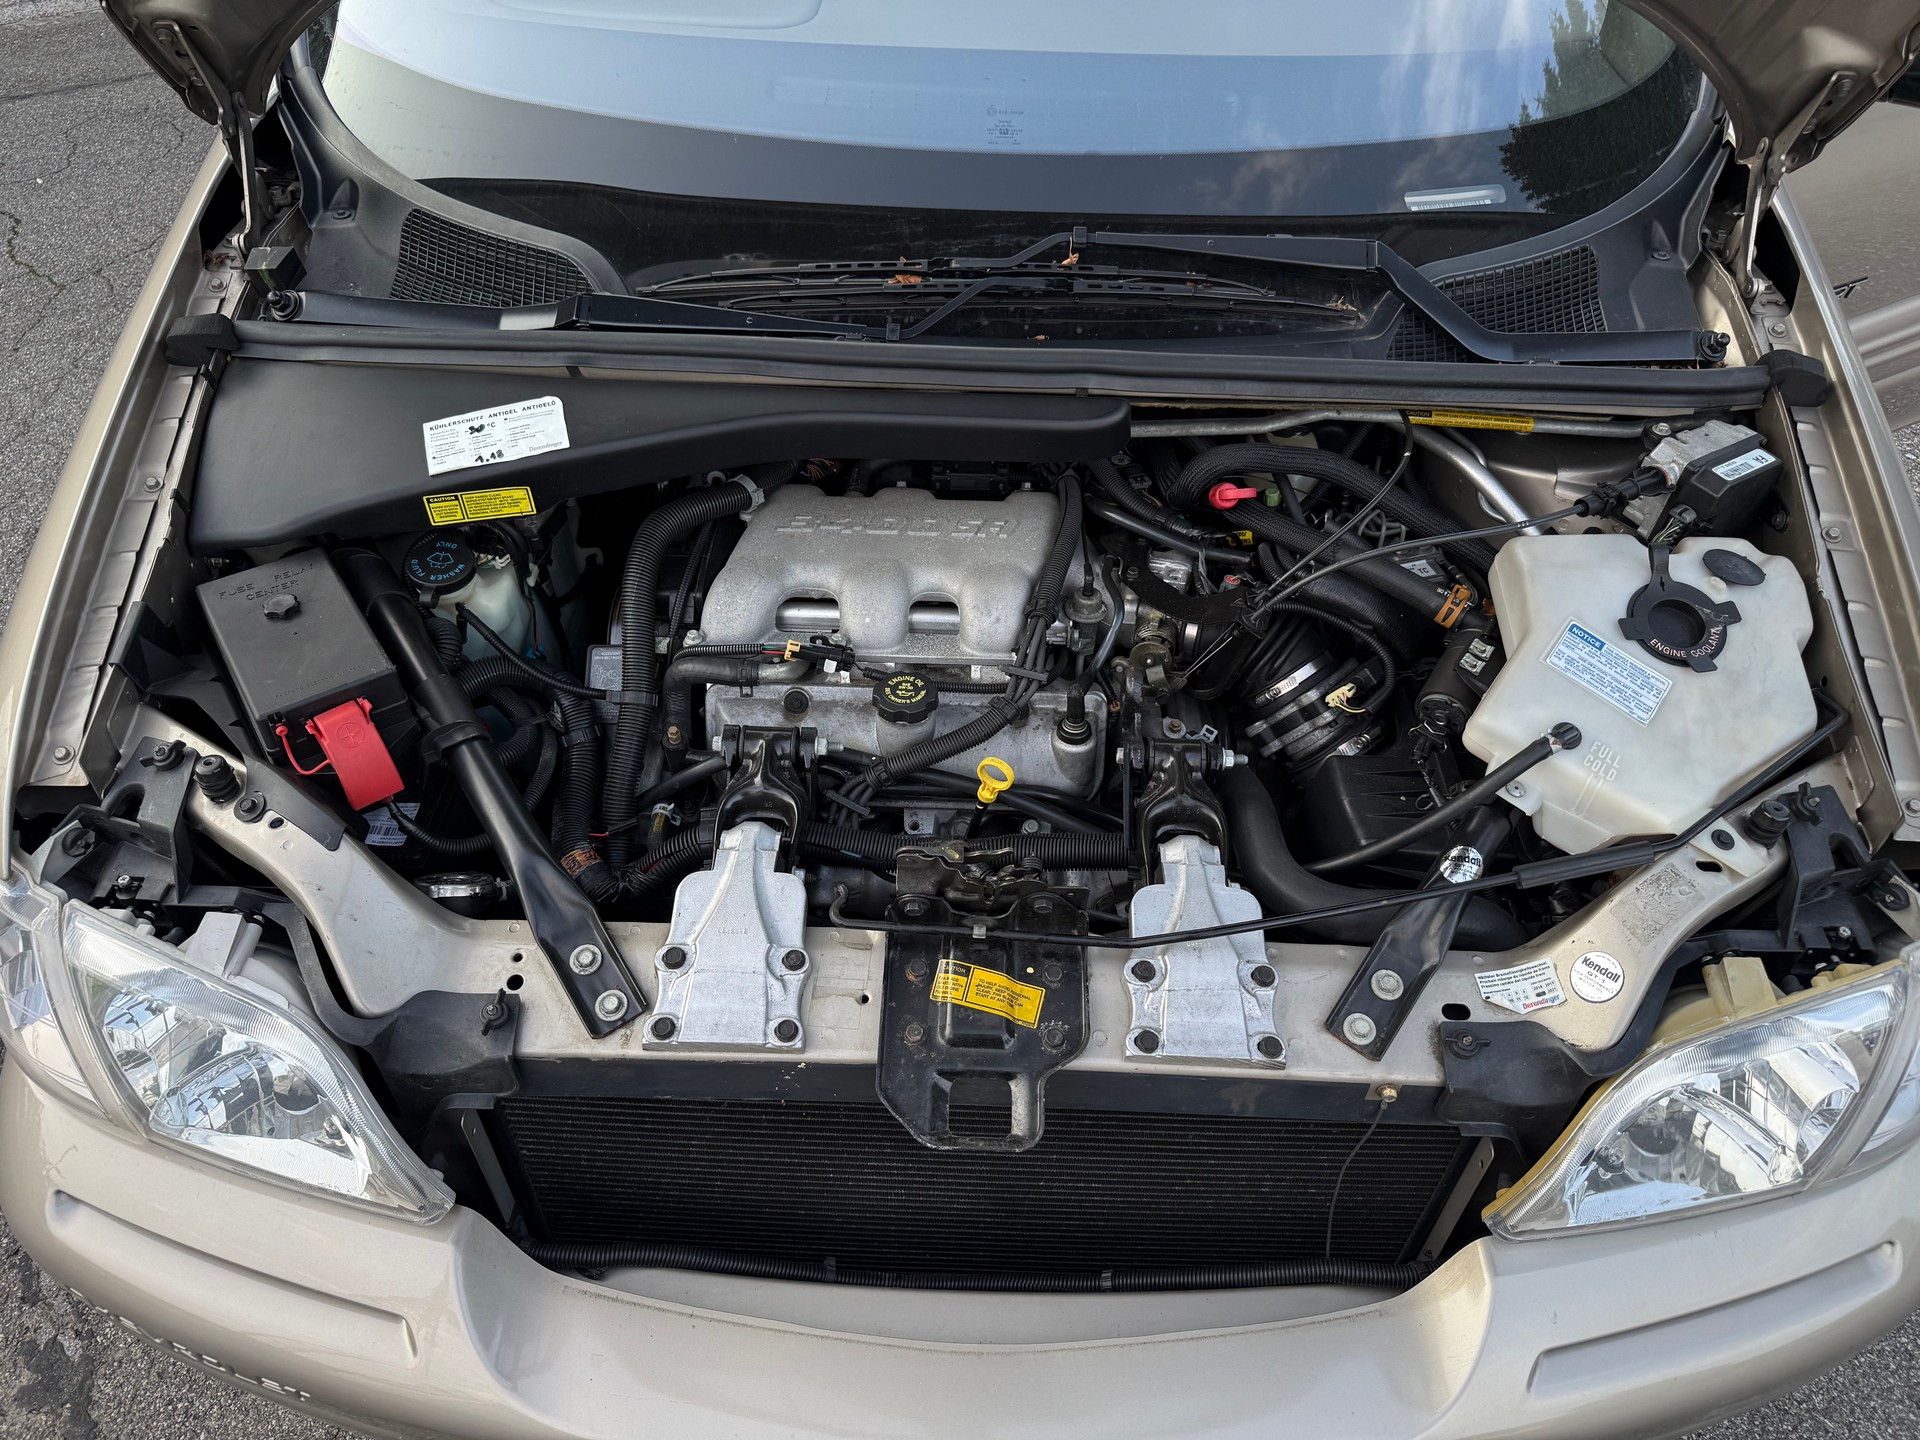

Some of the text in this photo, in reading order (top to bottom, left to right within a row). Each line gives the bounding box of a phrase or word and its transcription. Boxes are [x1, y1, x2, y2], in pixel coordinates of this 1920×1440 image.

[429, 415, 484, 431] KÜHLERSCHUTZ
[488, 409, 518, 419] ANTIGEL
[1752, 454, 1769, 464] FA
[436, 541, 458, 549] ONLY
[430, 563, 465, 580] WASHER
[219, 583, 255, 599] FUSE
[246, 580, 299, 600] CENTER
[1571, 626, 1601, 648] NOTICE
[1650, 625, 1724, 658] ENGINE COOLANT
[888, 675, 915, 686] ENGINE
[1590, 740, 1621, 768] FULL
[1583, 756, 1618, 782] COLD
[1581, 955, 1621, 983] Kendall
[1522, 993, 1560, 1009] Derendinger
